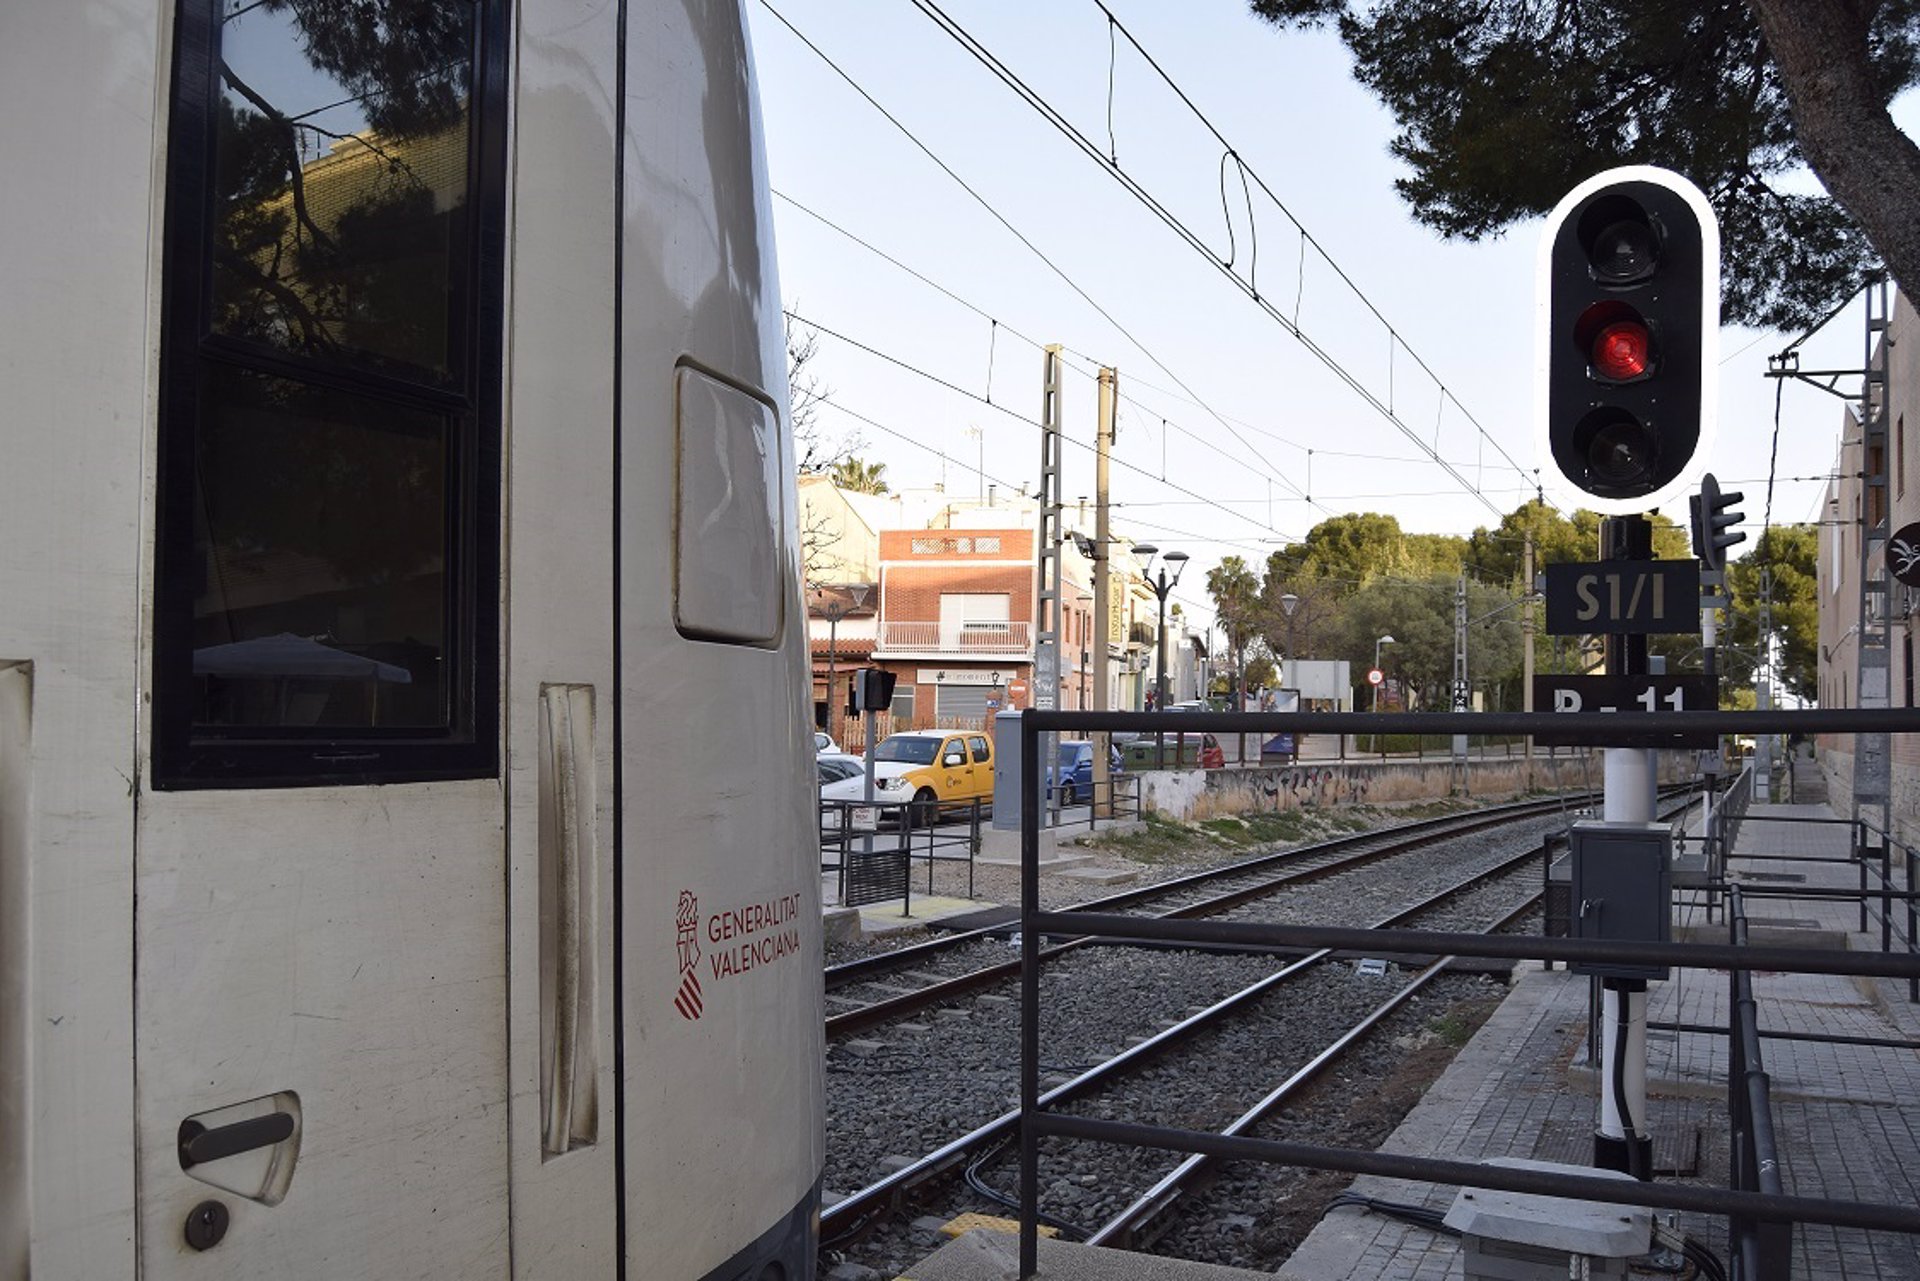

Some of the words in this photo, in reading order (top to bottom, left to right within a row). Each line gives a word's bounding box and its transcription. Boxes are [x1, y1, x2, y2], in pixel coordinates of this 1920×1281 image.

[1636, 686, 1684, 713] 11
[708, 893, 801, 943] GENERALITAT
[710, 929, 801, 981] VALENCIANA
